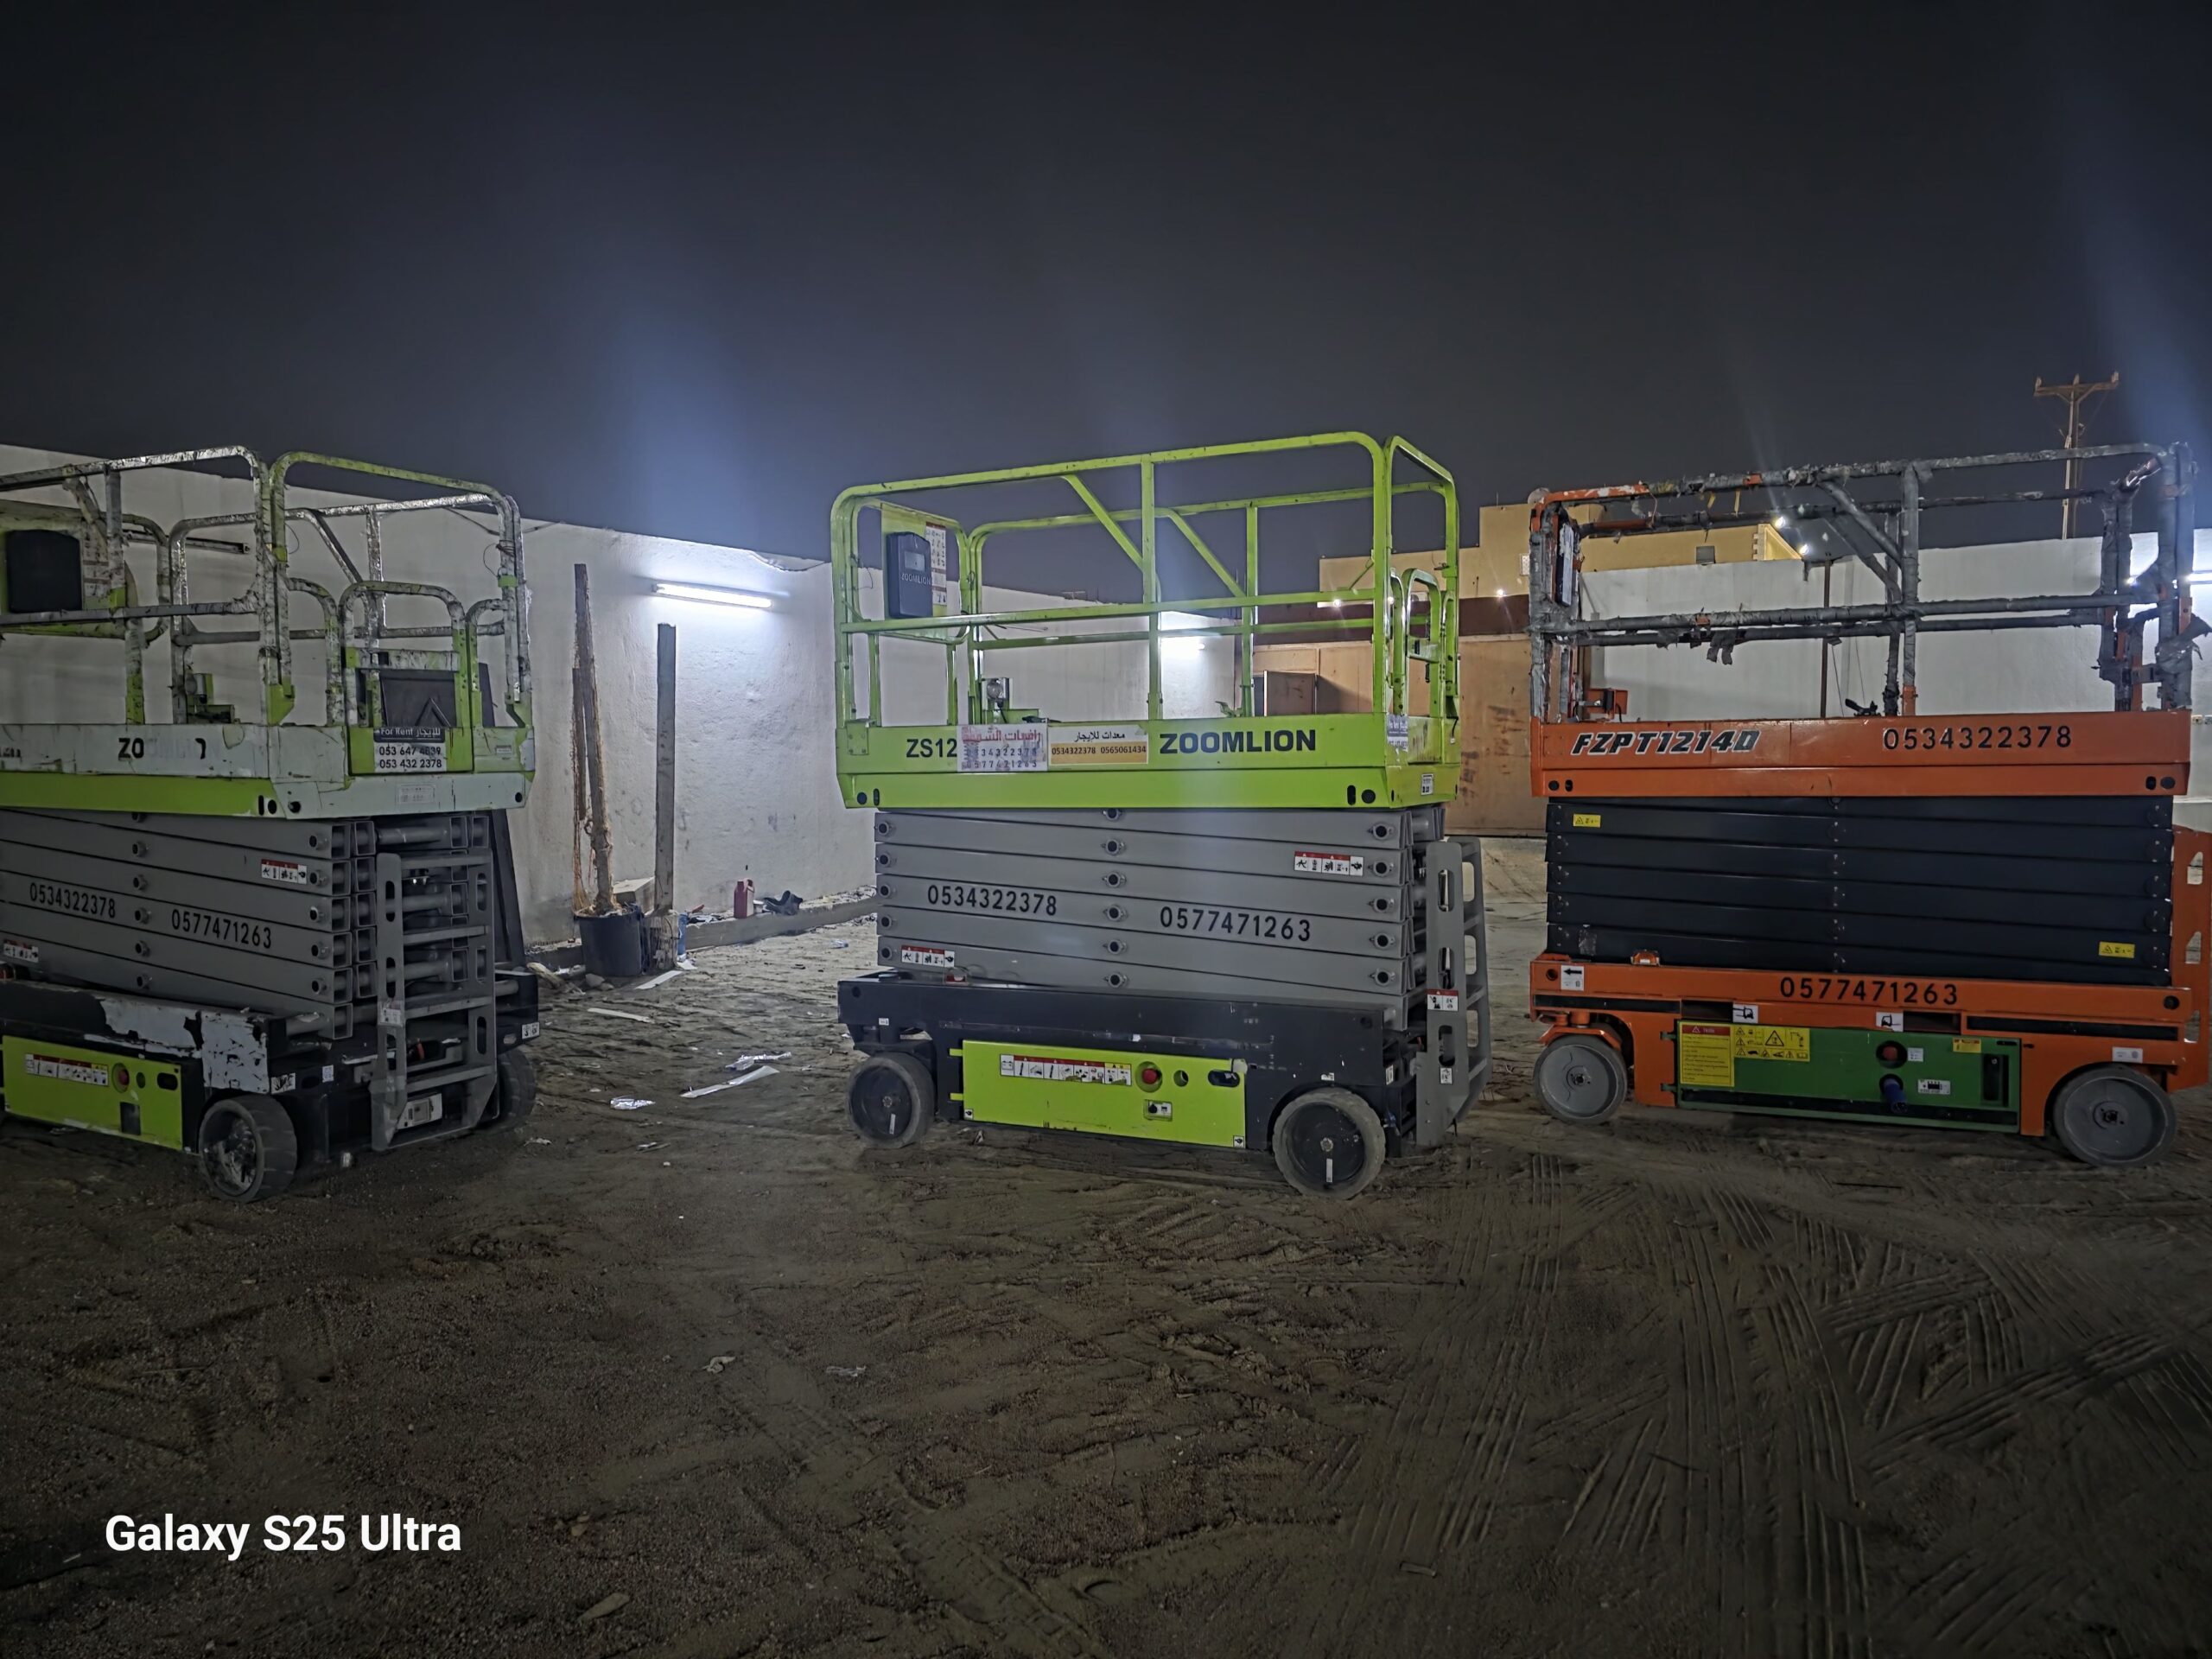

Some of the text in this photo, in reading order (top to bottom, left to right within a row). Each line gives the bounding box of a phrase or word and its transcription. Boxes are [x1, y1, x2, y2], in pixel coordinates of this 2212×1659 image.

[901, 573, 931, 584] ZOOMLION
[1102, 731, 1126, 740] معدات
[1160, 729, 1316, 754] ZOOMLION
[1570, 729, 1761, 755] FZPT1214D
[1883, 726, 2071, 750] 0534322378
[379, 746, 397, 756] 053
[400, 746, 416, 756] 647
[906, 739, 957, 758] ZS12
[1052, 746, 1147, 755] 0534322378 0565061434
[379, 759, 442, 769] 053 432 2378
[29, 882, 116, 918] 0534322378
[927, 885, 1057, 916] 0534322378
[172, 908, 272, 949] 0577471263
[1160, 906, 1311, 942] 0577471263
[1780, 976, 1957, 1005] 0577471263
